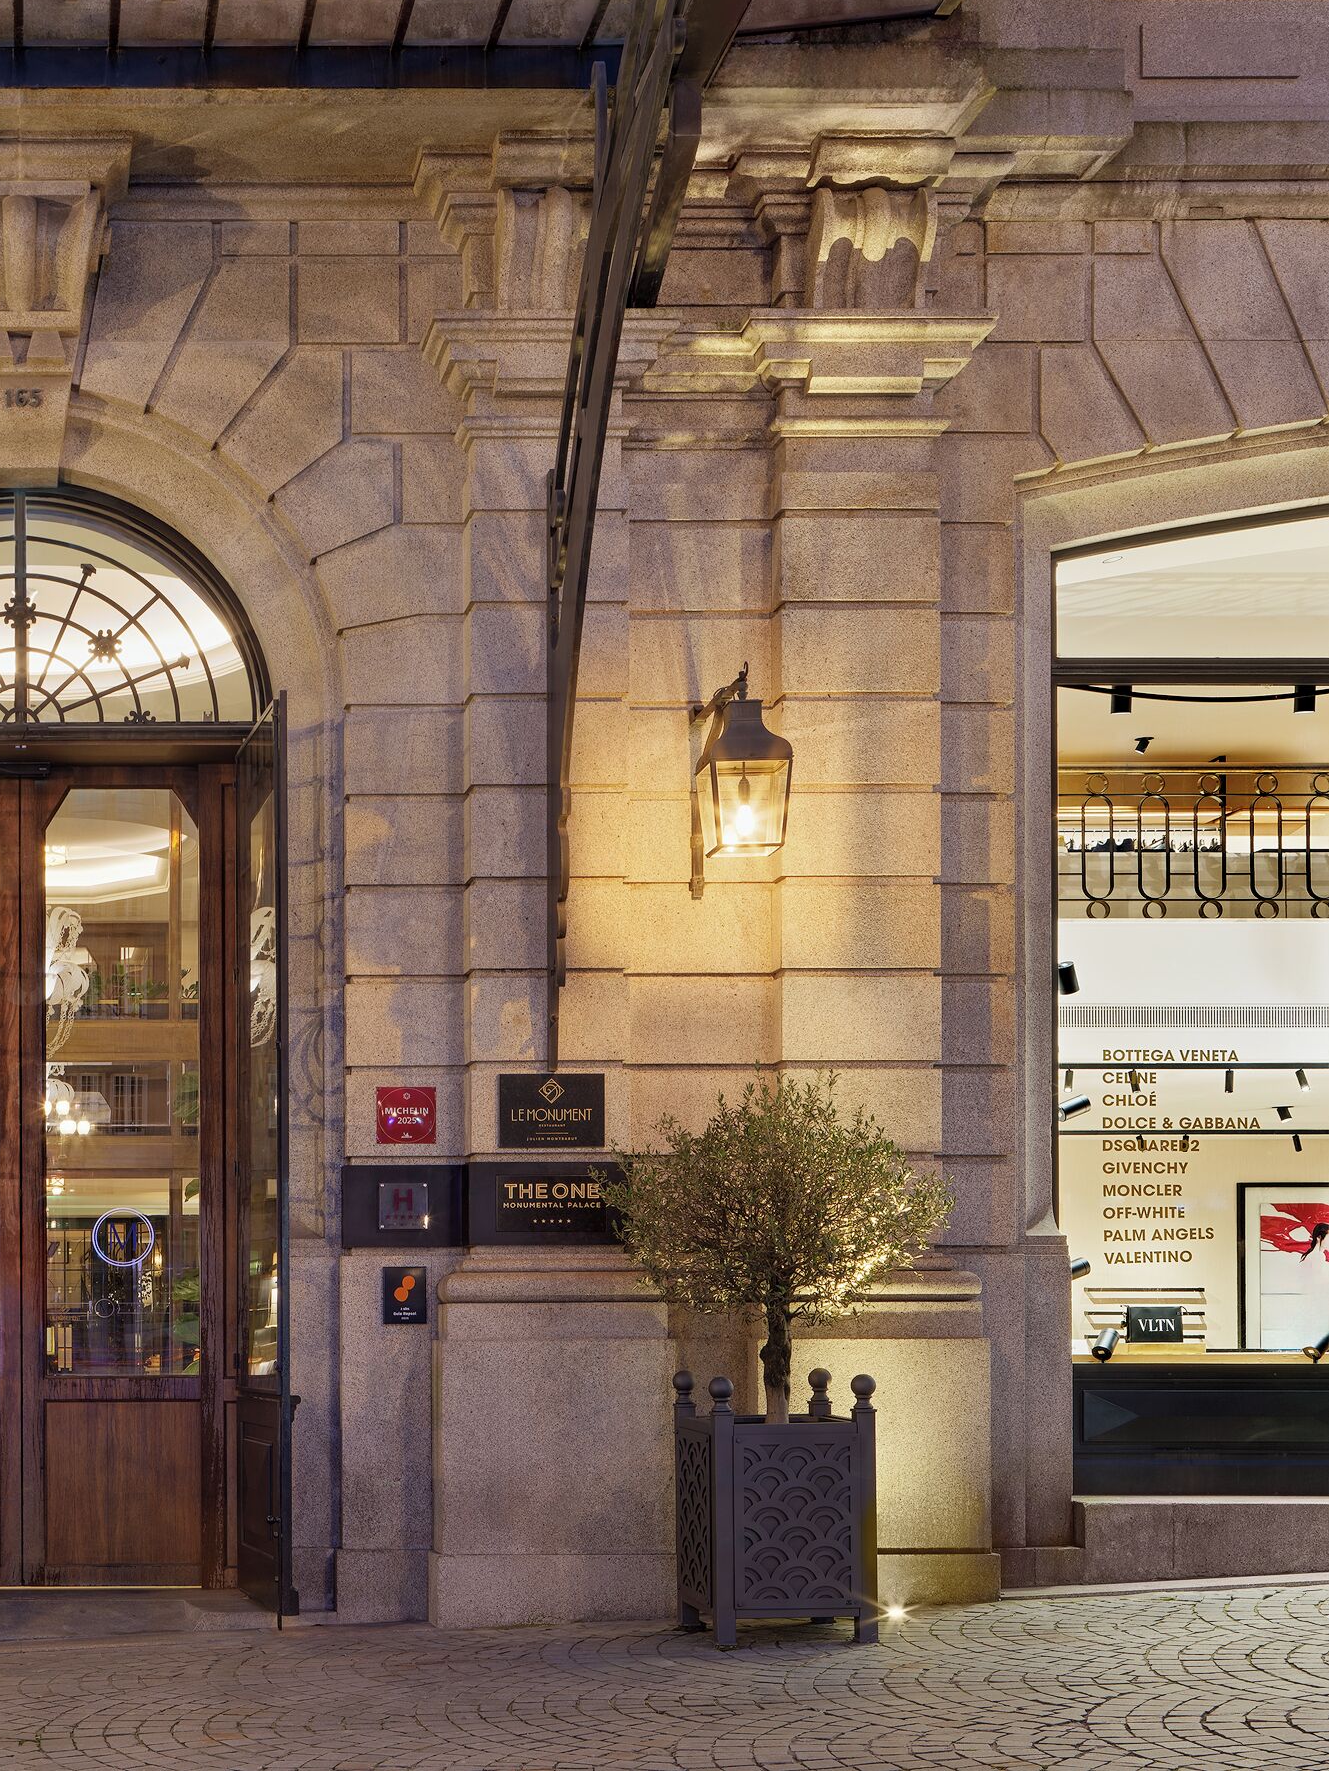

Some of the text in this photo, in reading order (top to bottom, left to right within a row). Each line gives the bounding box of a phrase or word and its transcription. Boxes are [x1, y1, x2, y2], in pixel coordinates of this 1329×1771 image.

[4, 388, 44, 408] 165
[1102, 1049, 1239, 1062] BOTTEGA VENETA
[1102, 1072, 1157, 1084] CELINE
[1102, 1091, 1157, 1107] CHLOÉ
[384, 1107, 429, 1115] MICHELIN
[511, 1108, 593, 1122] LE MONUMENT
[397, 1116, 418, 1125] 2025
[1102, 1117, 1261, 1129] DOLCE & GABBANA
[1102, 1139, 1200, 1152] DSQUARED2
[1102, 1162, 1189, 1175] GIVENCHY
[504, 1182, 600, 1199] THE ONE
[1102, 1184, 1183, 1197] MONCLER
[1102, 1206, 1185, 1219] OFF-WHITE
[1103, 1227, 1214, 1242] PALM ANGELS
[1104, 1250, 1193, 1264] VALENTINO
[1138, 1318, 1175, 1332] VLTN
